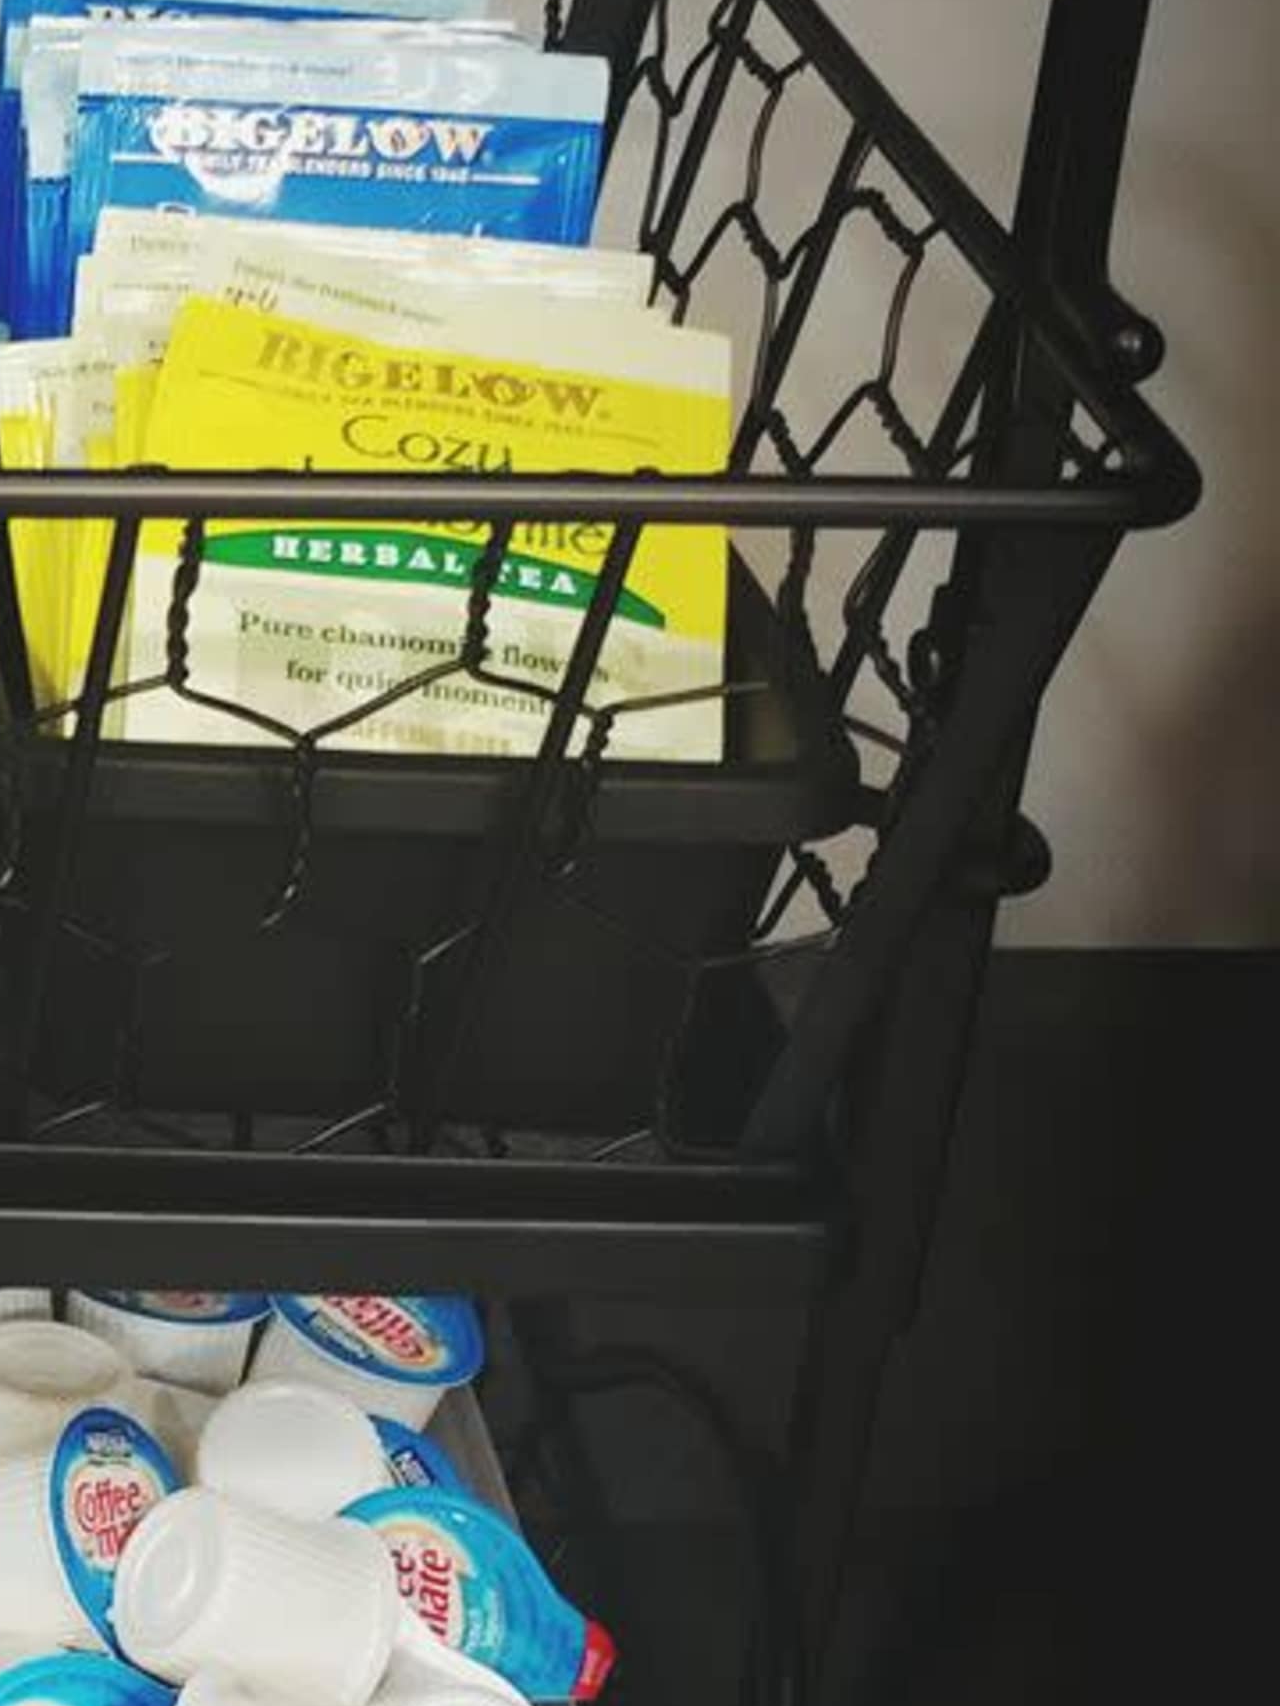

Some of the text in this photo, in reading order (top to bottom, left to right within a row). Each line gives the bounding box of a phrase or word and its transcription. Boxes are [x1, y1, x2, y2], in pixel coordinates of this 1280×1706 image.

[162, 104, 495, 165] BIGELOW
[255, 330, 604, 419] BIGELOW
[272, 535, 465, 575] HERBAL
[239, 611, 314, 641] Pure
[285, 659, 327, 684] for
